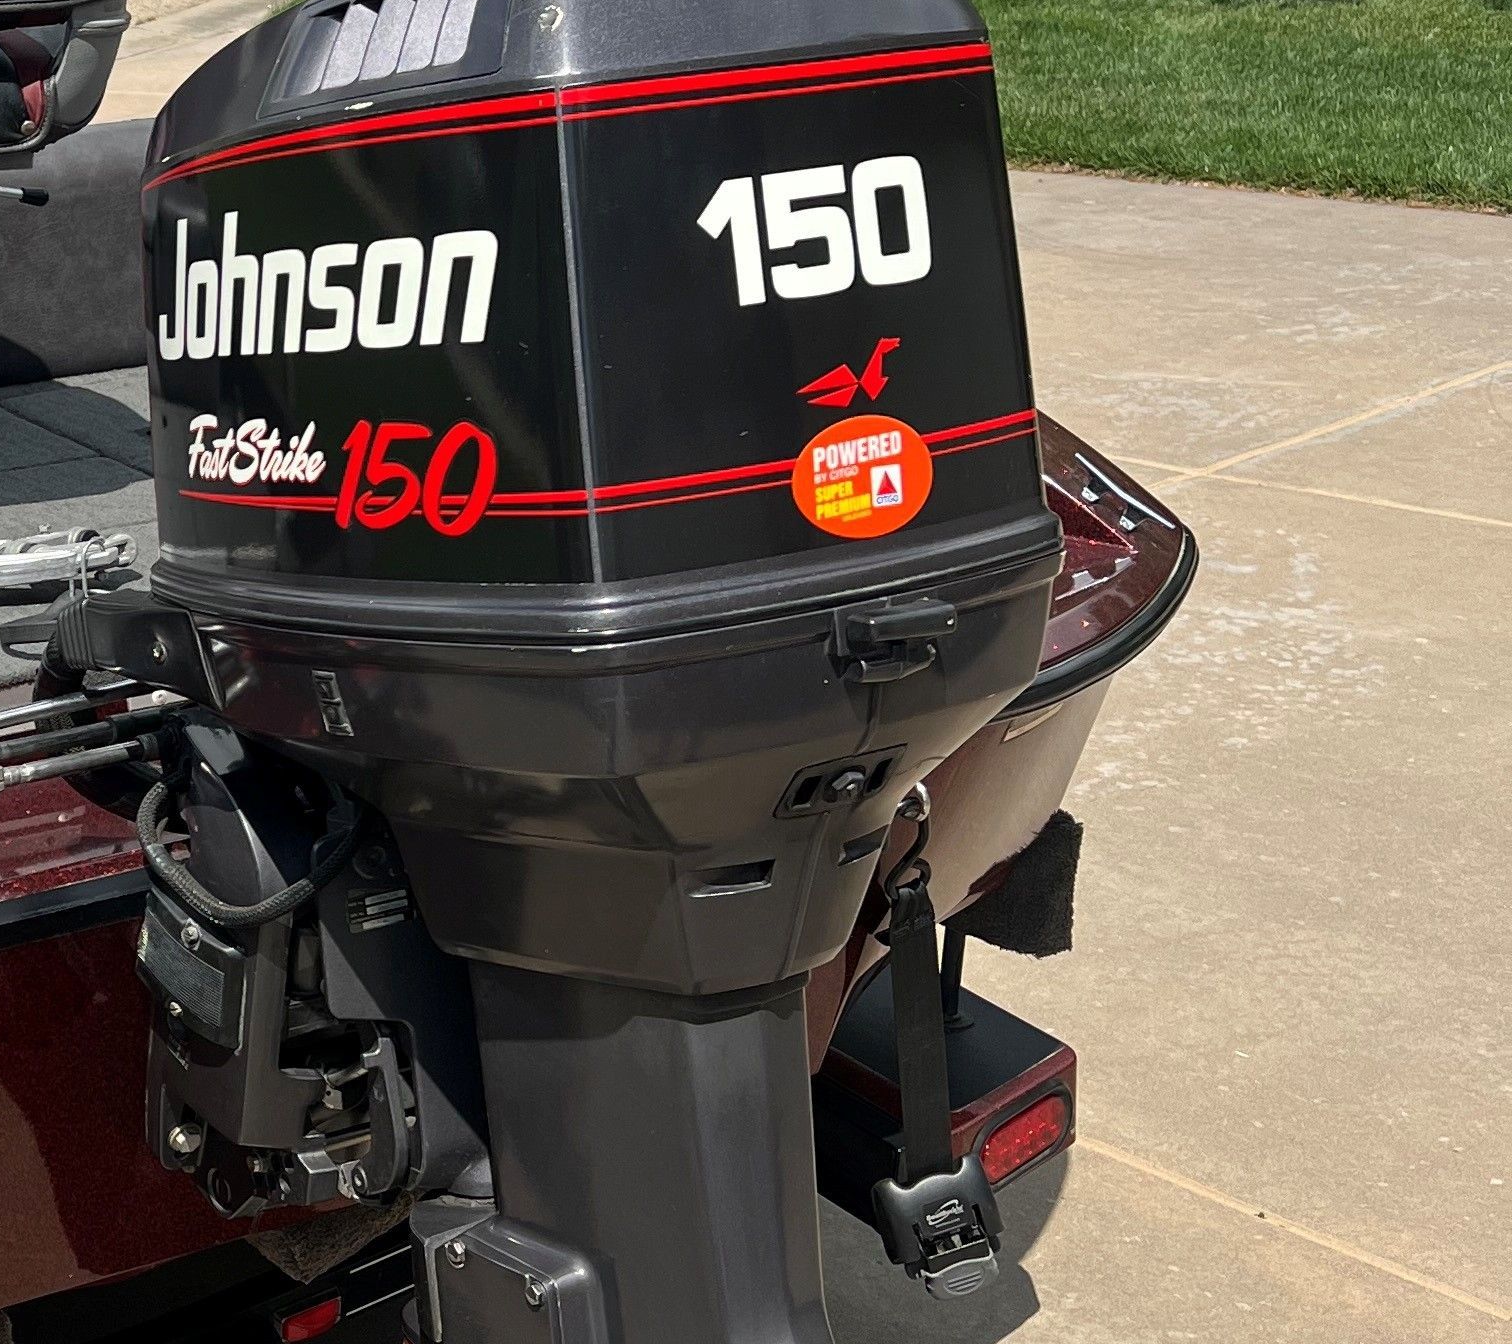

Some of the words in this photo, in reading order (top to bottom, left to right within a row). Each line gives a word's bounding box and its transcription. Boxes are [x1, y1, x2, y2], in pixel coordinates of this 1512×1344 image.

[696, 155, 932, 307] 150
[159, 210, 499, 360] Johnson
[335, 419, 497, 537] 150
[812, 429, 903, 473] POWERED
[815, 480, 853, 504] SUPER
[815, 493, 872, 521] PREMIUM
